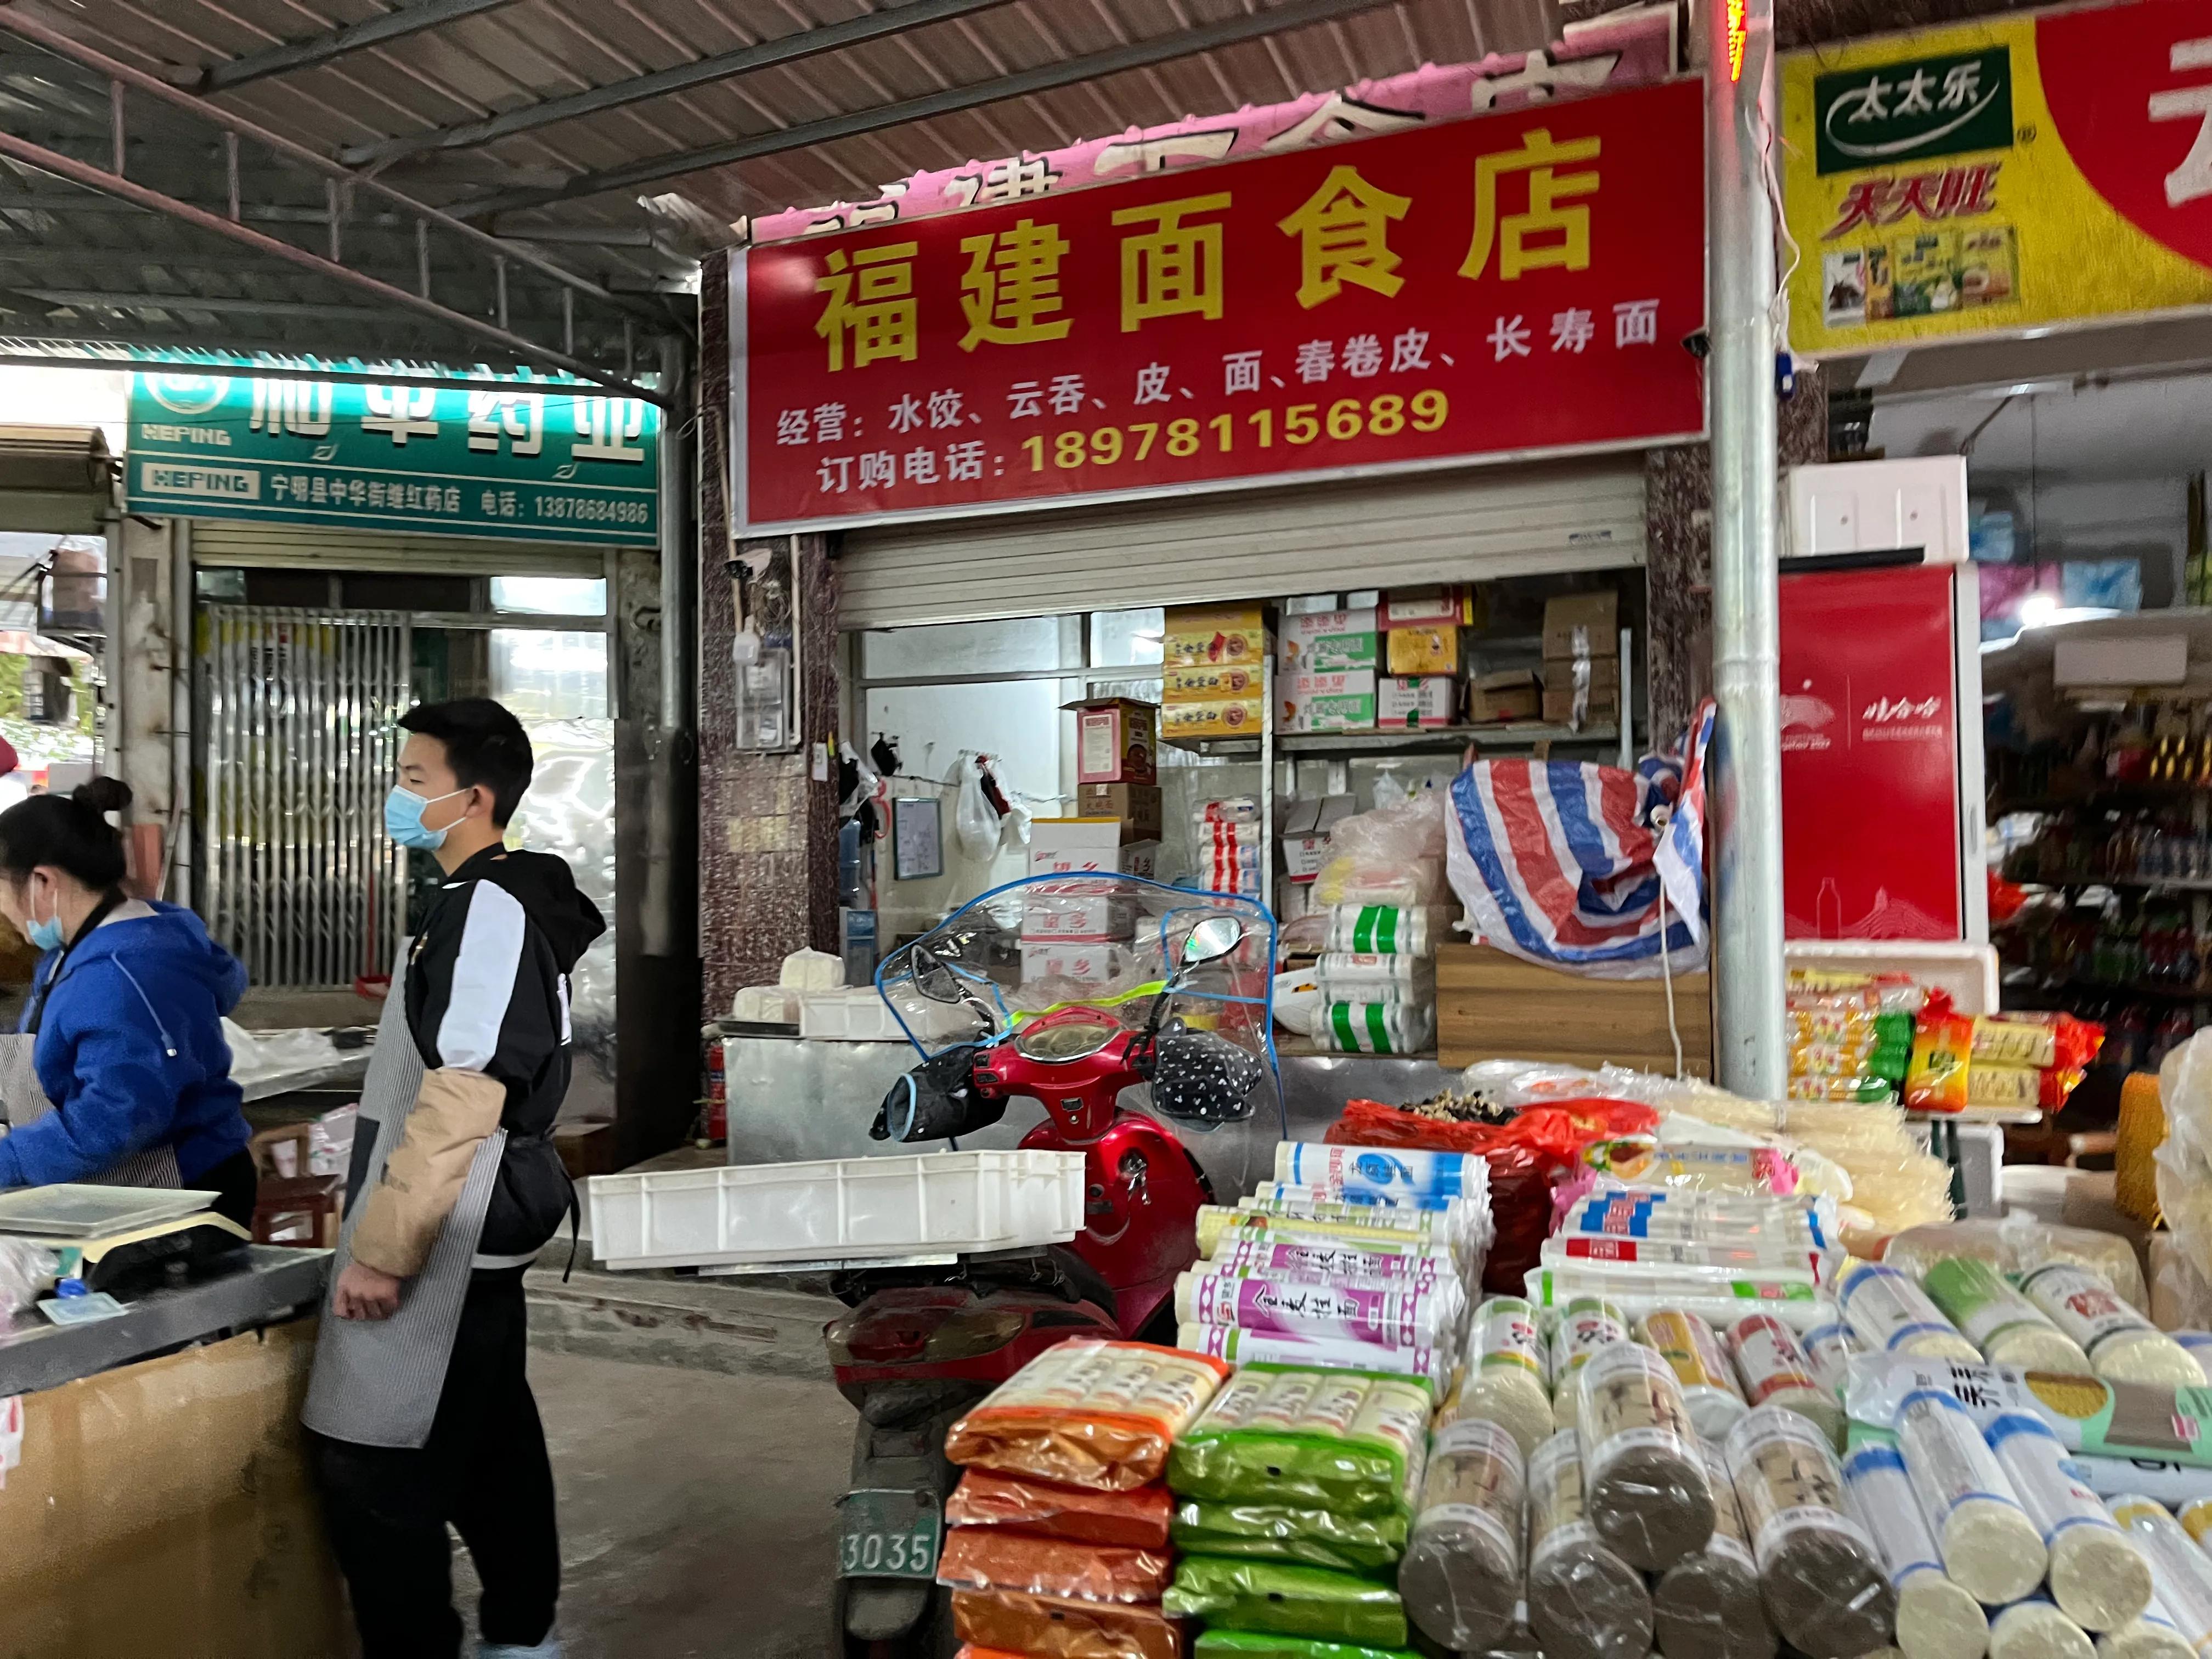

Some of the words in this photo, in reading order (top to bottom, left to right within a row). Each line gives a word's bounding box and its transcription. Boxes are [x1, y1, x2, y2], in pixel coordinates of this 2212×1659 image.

[1848, 59, 1982, 125] 太太乐
[814, 127, 1601, 372] 福建面食店
[141, 424, 232, 446] HEPING
[154, 469, 249, 493] HEPING
[843, 1534, 931, 1572] 3035
